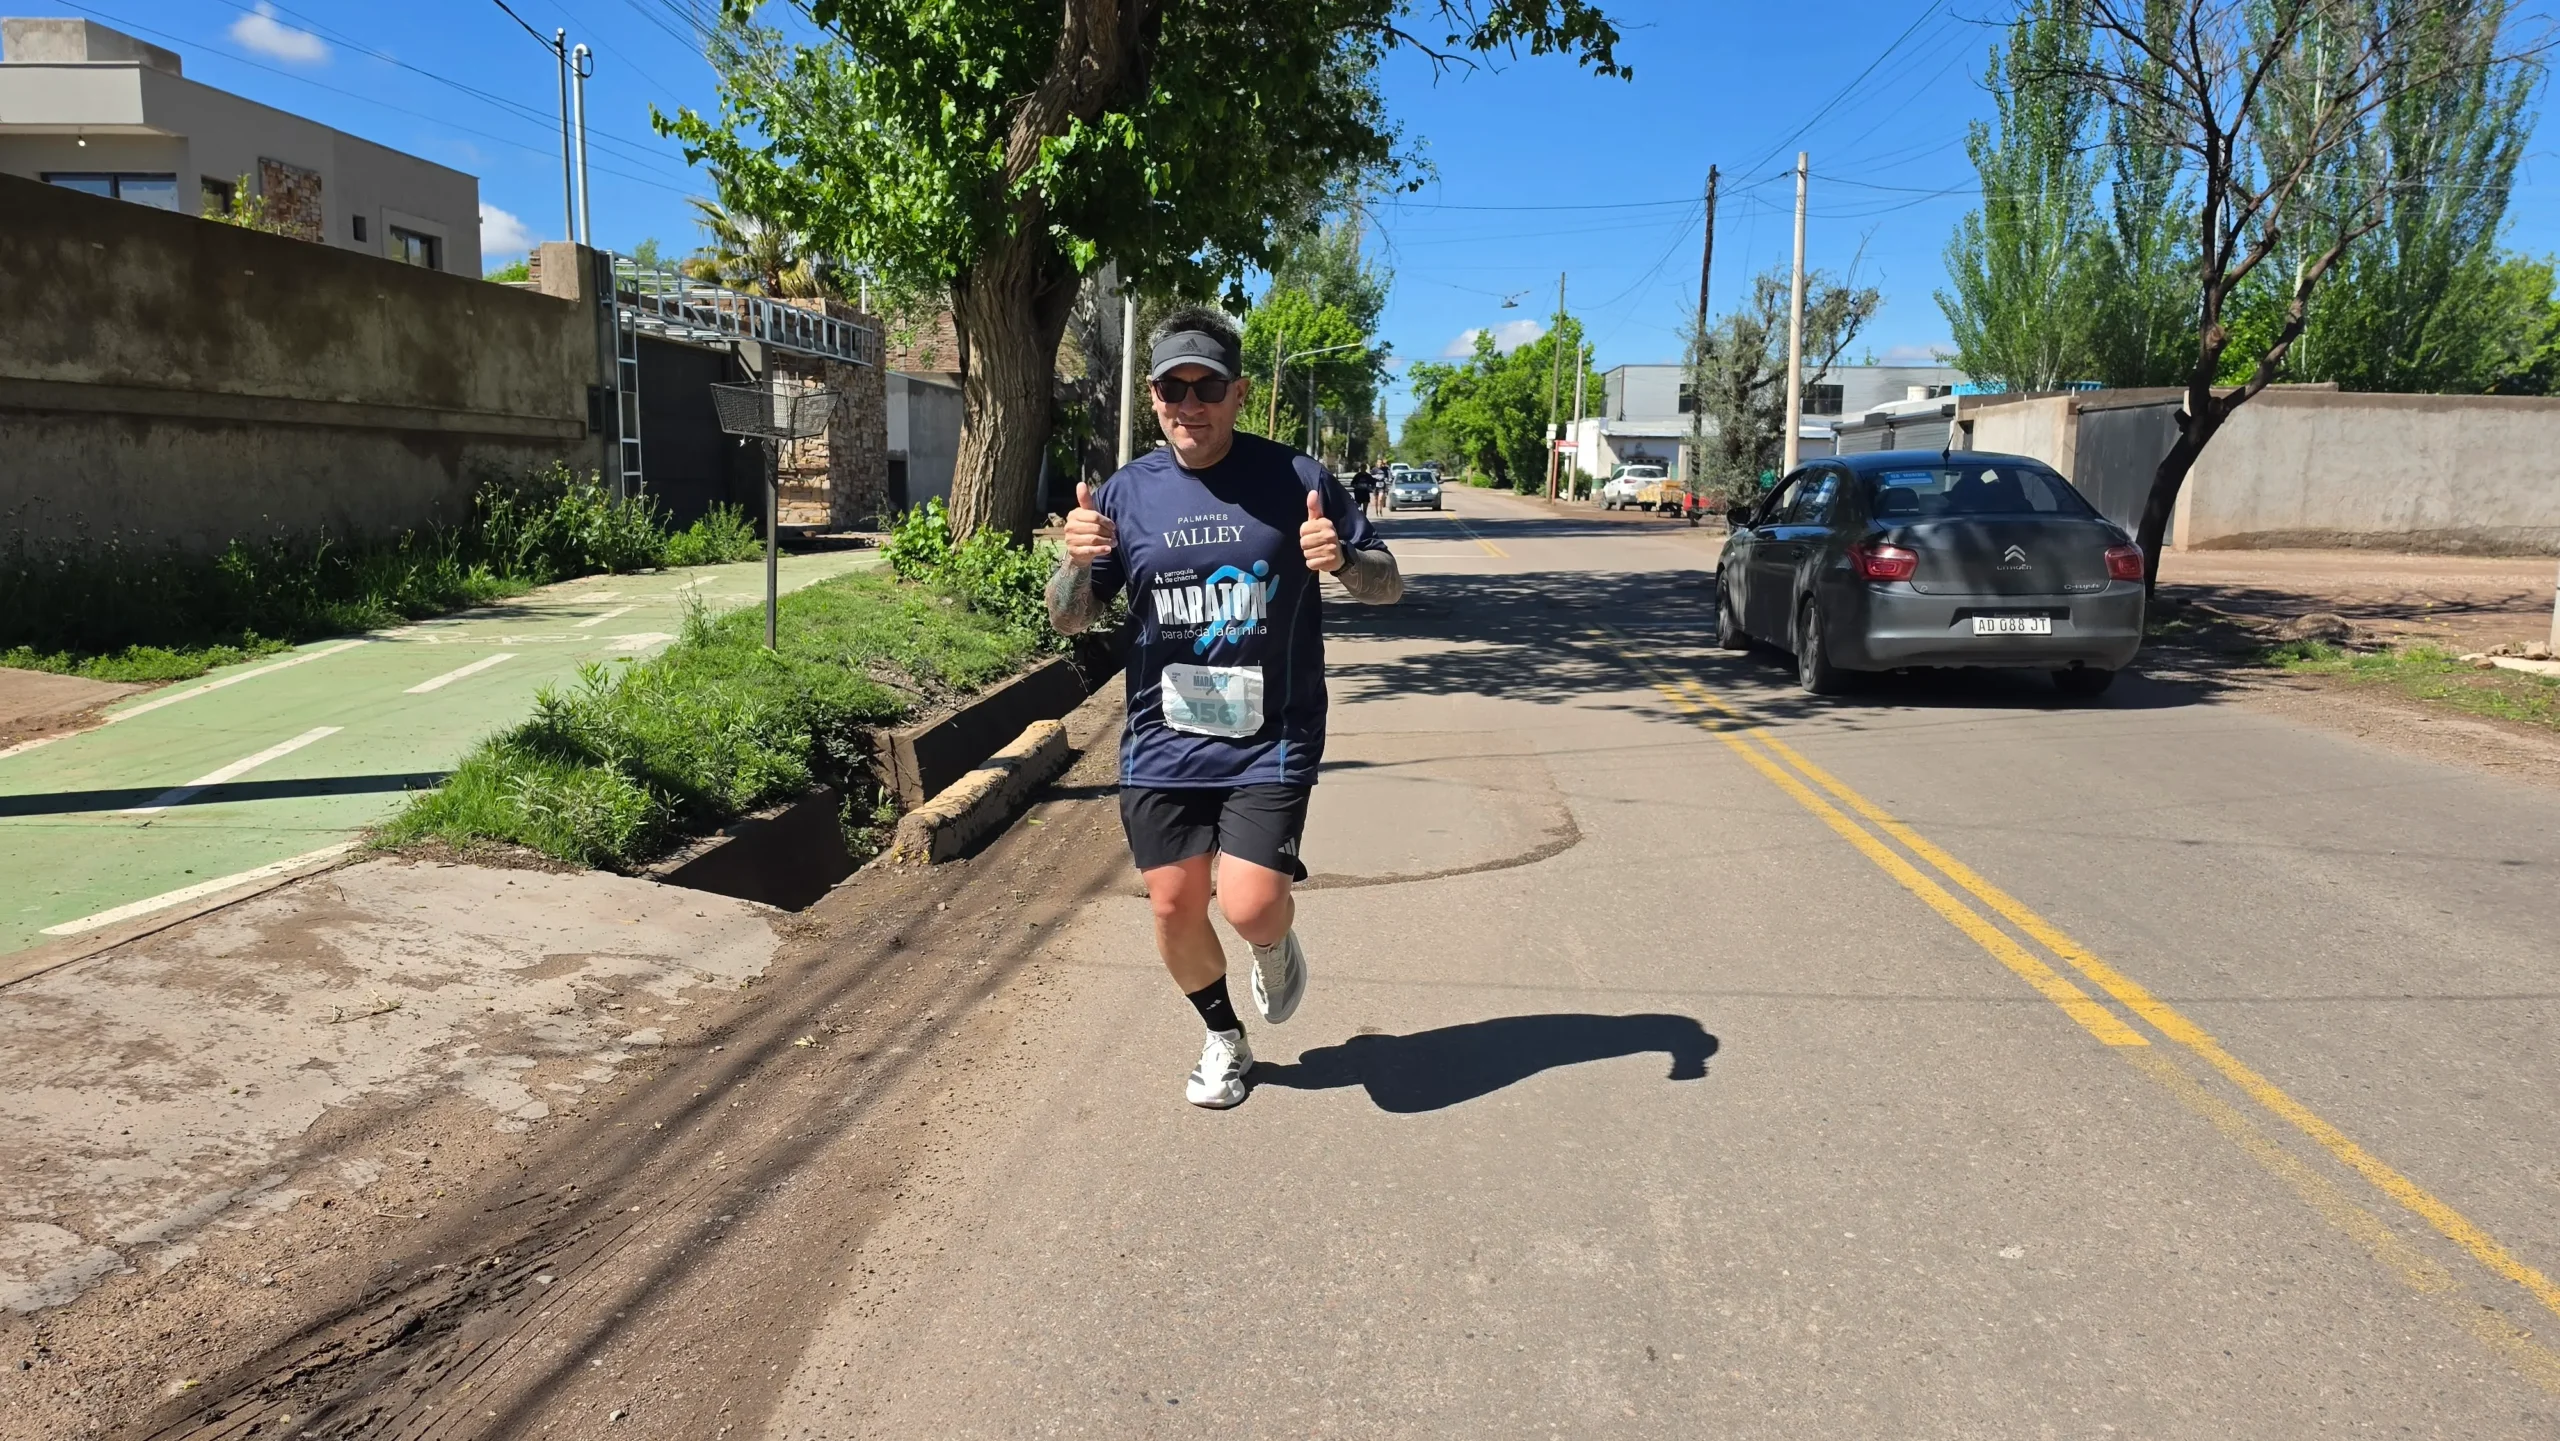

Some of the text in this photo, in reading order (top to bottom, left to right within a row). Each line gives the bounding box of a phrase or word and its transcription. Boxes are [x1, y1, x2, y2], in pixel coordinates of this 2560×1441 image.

[1177, 513, 1229, 524] PALMARES
[1163, 525, 1245, 548] VALLEY
[1165, 574, 1198, 583] de chacras
[1151, 573, 1267, 625] MARATÓN
[1161, 623, 1268, 640] para toda la familia
[1978, 618, 2047, 631] AD 088 JT
